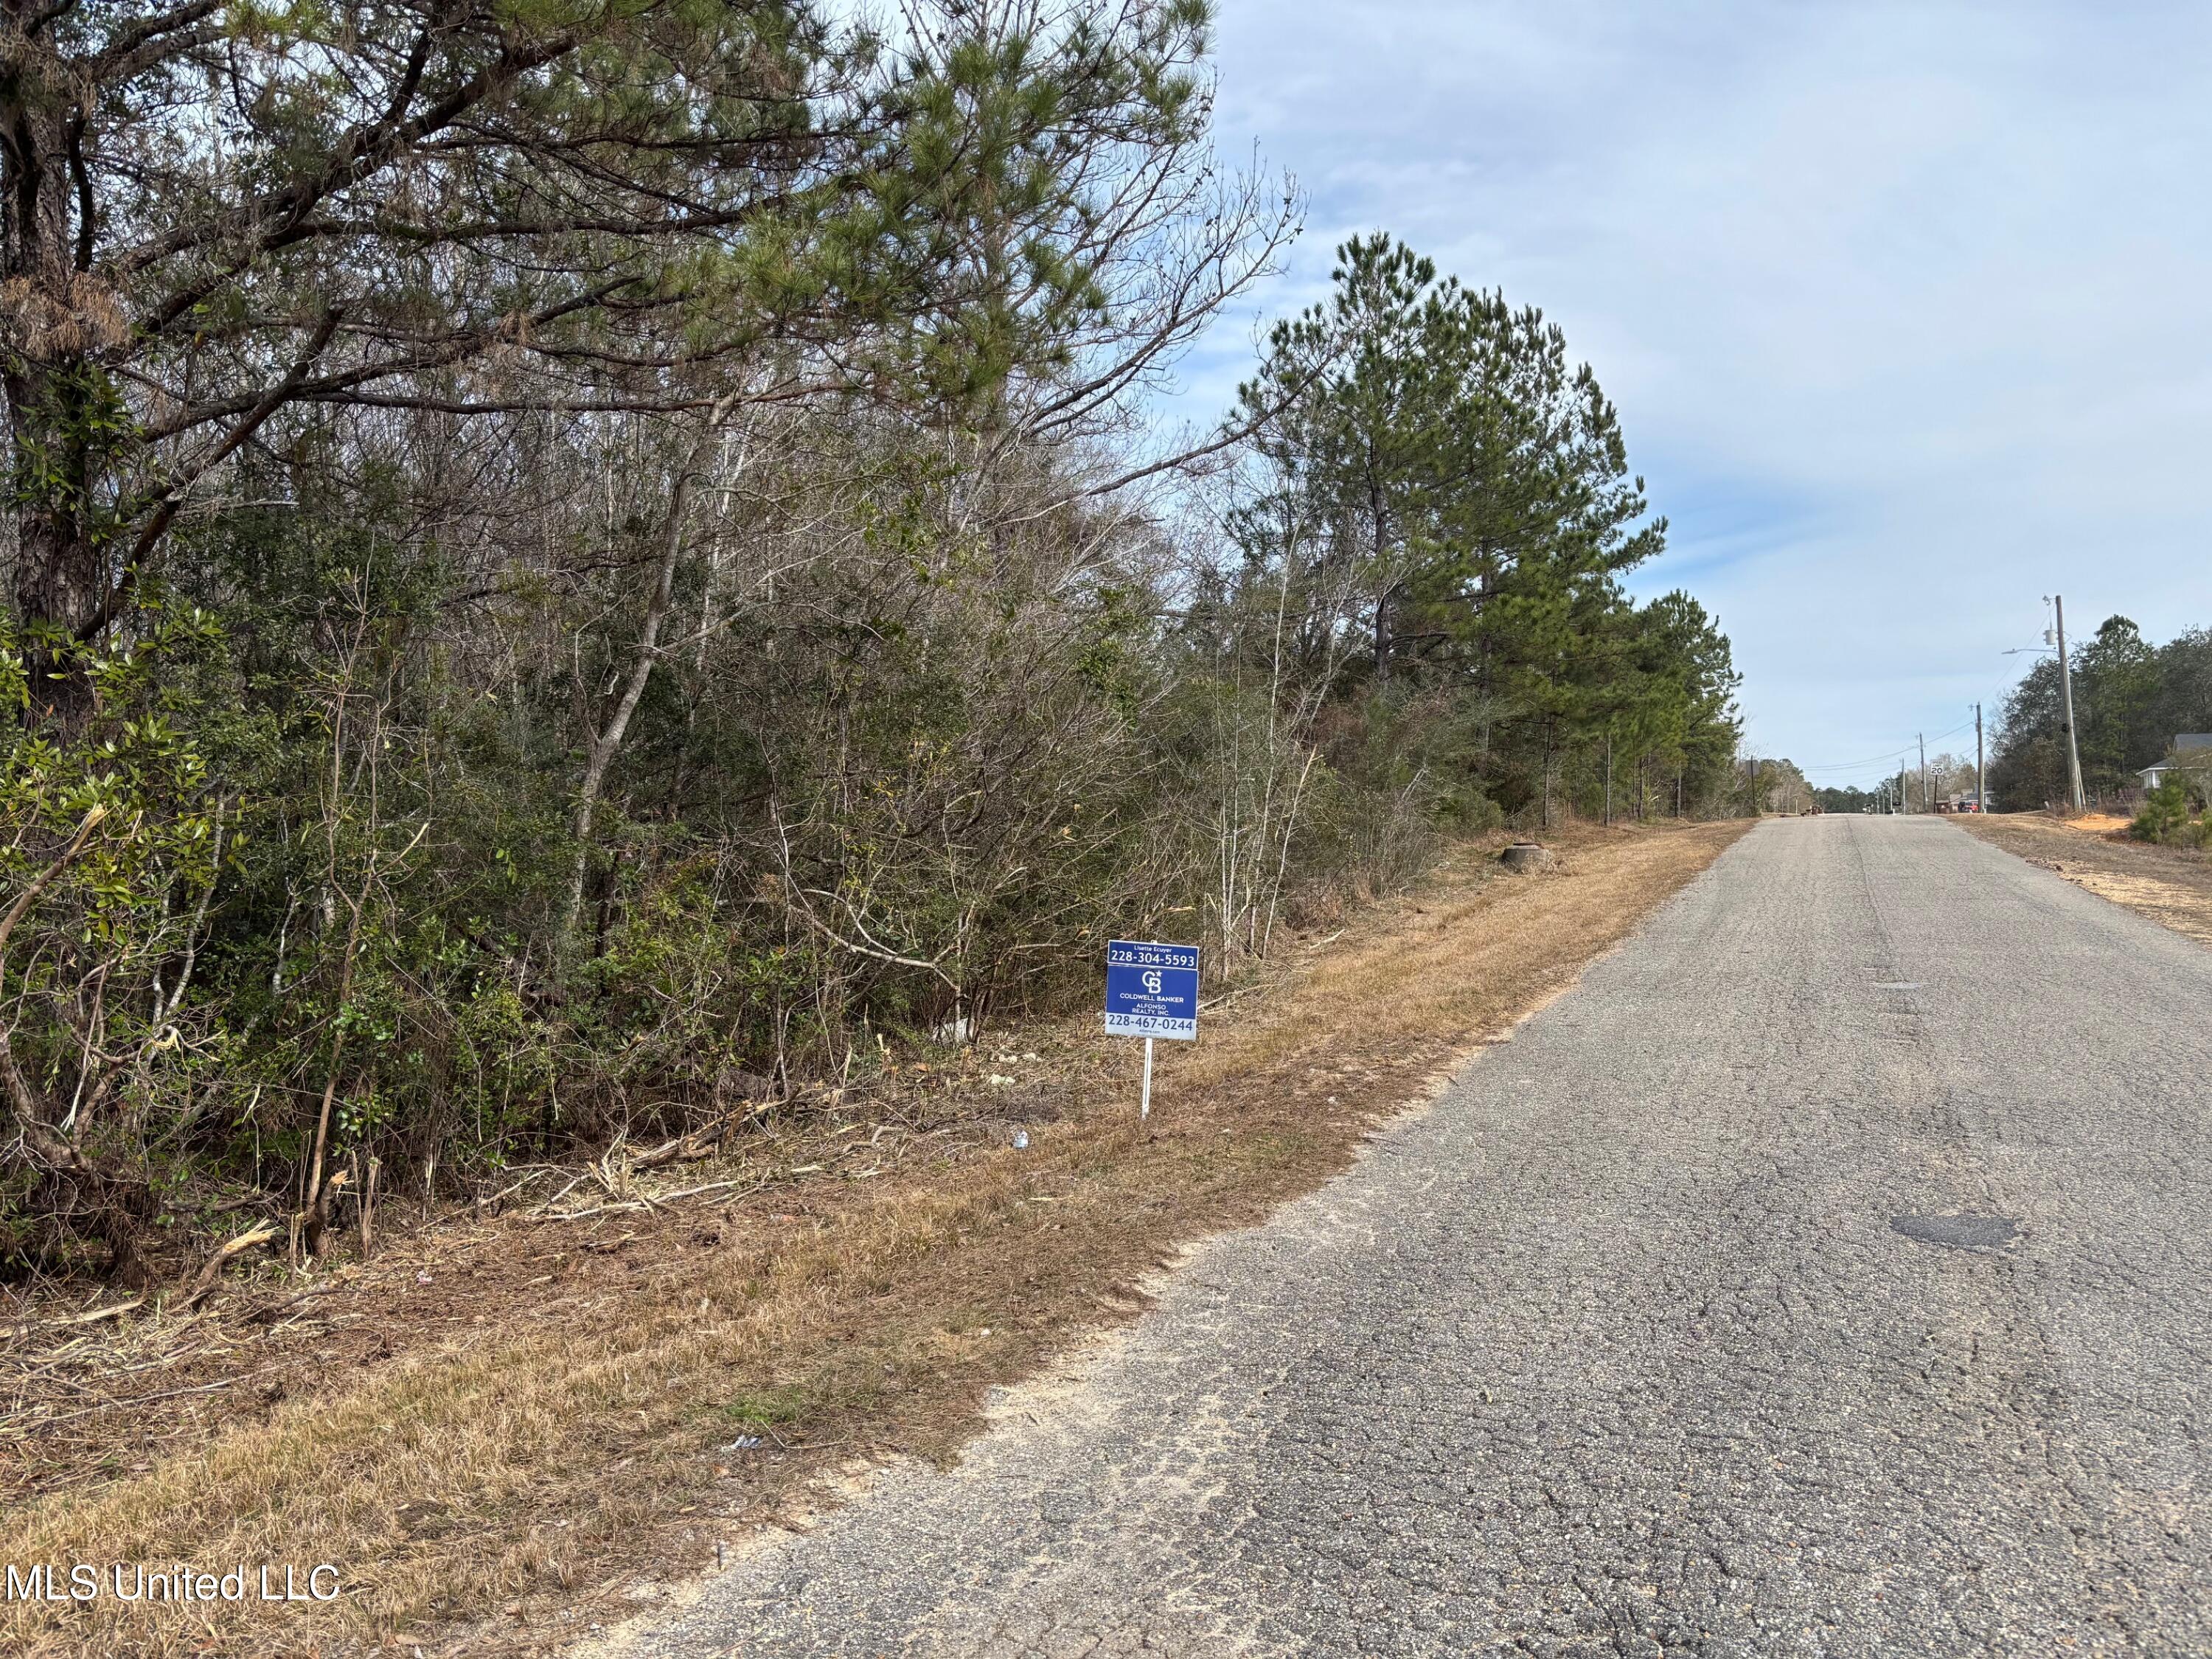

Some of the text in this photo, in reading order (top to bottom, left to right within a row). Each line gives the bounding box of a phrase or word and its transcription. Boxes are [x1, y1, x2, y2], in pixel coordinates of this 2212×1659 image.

[1111, 950, 1194, 966] 228-304-5593
[1120, 993, 1155, 1001] COLDWELL
[1109, 1015, 1192, 1031] 228-467-0244
